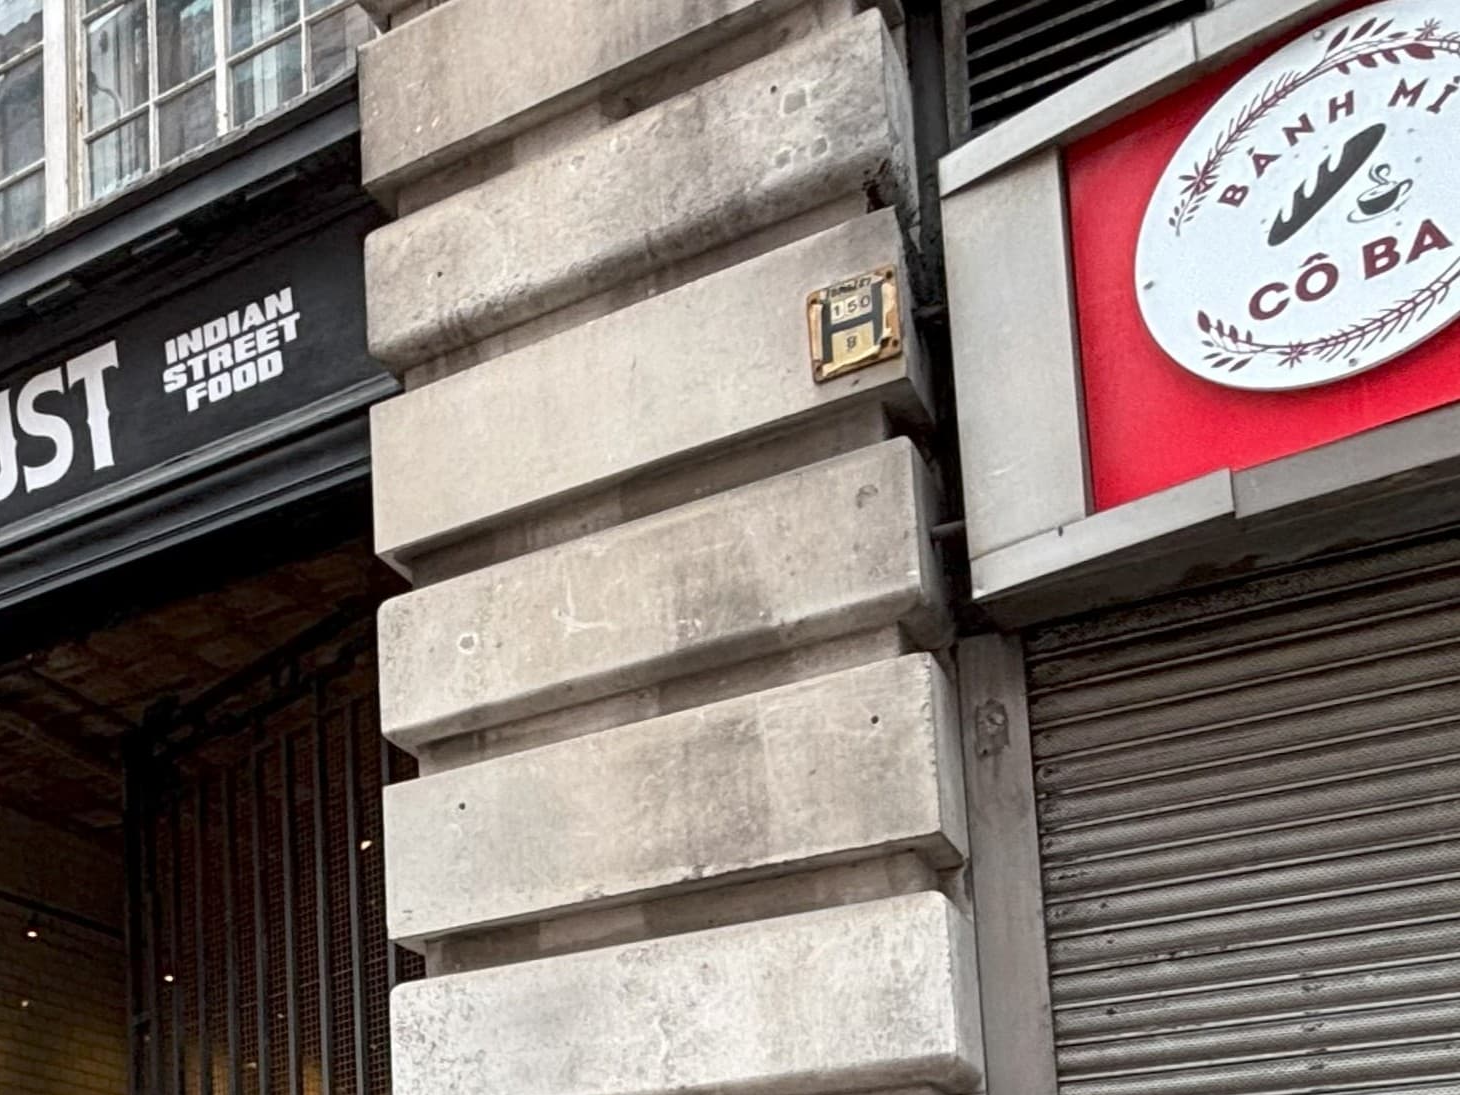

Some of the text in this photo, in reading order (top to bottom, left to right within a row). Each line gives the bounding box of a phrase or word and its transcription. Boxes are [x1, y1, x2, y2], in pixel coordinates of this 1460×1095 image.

[833, 295, 871, 317] 150
[1248, 218, 1454, 321] CÔ BA
[162, 311, 301, 394] STREET
[164, 286, 294, 366] INDIAN
[185, 350, 285, 413] FOOD
